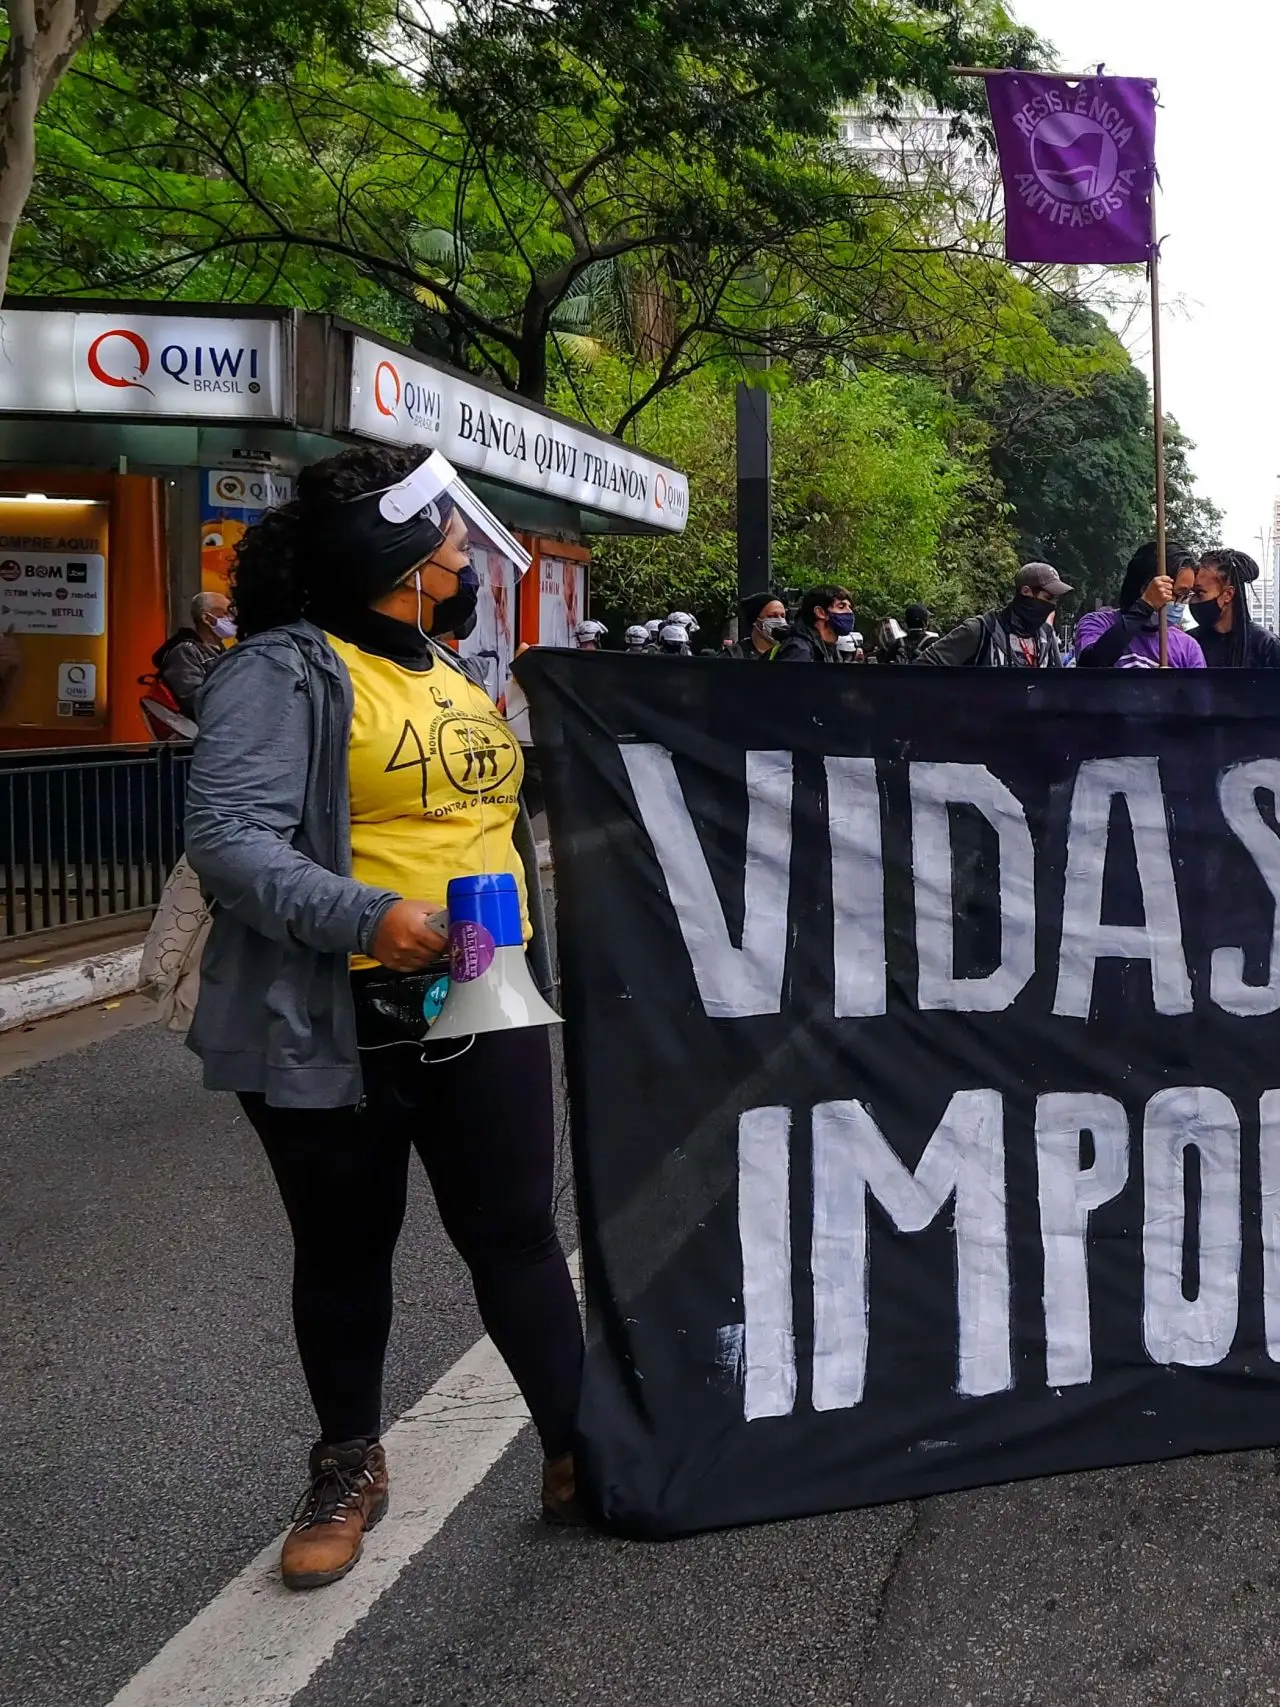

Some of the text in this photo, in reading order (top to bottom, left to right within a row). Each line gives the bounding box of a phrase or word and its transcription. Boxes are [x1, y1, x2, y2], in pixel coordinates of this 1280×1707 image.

[1012, 83, 1135, 148] RESISÊNCIA
[1014, 168, 1136, 227] ANTIFASCISTA
[160, 345, 257, 385] QIWI
[193, 379, 243, 394] BRASIL
[404, 382, 440, 420] QIWI
[413, 416, 433, 432] BRASIL
[458, 401, 648, 501] BANCA QIWI TRIANON
[667, 486, 685, 510] QIWI
[0, 536, 52, 549] OMPRE
[51, 608, 84, 617] NETFLIX
[471, 799, 478, 808] O
